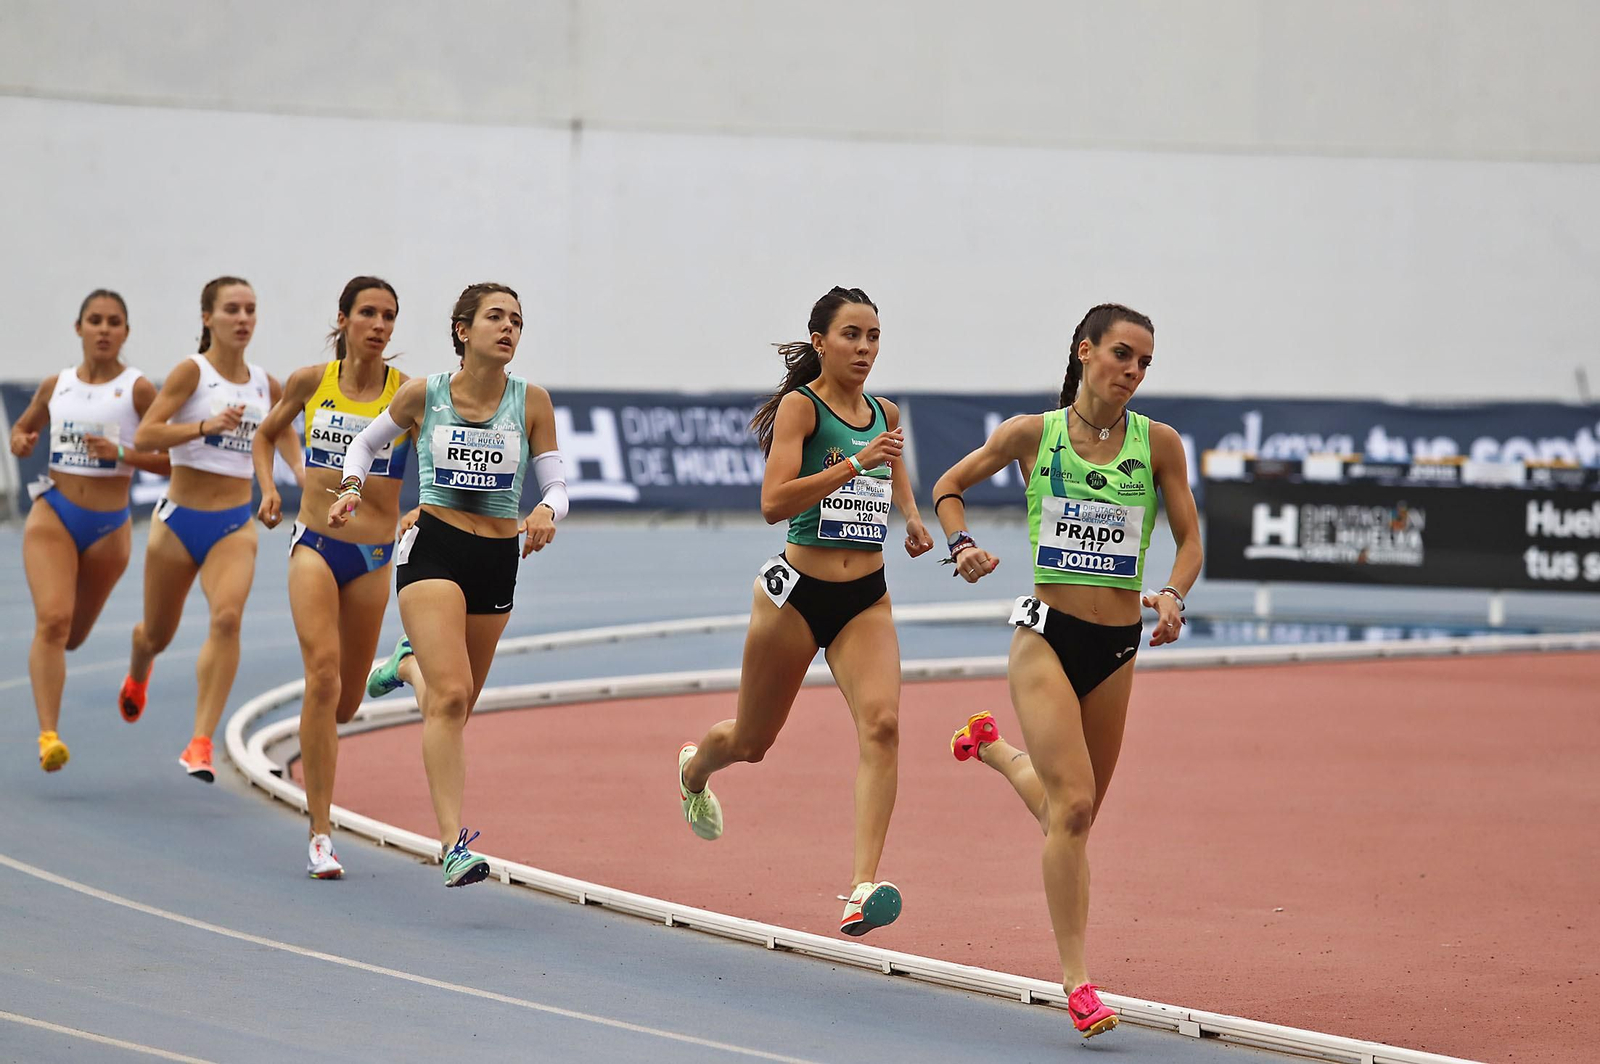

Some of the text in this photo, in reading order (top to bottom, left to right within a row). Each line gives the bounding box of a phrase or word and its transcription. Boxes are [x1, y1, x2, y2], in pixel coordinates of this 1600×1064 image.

[447, 447, 503, 464] RECIO
[466, 462, 487, 472] 118
[1119, 481, 1145, 491] Unicaja
[856, 512, 874, 522] 120
[1095, 513, 1126, 523] HUELVA
[1055, 521, 1125, 544] PRADO
[1079, 540, 1105, 552] 117
[1523, 545, 1580, 581] tus
[763, 564, 790, 596] 6
[1015, 598, 1042, 629] 3
